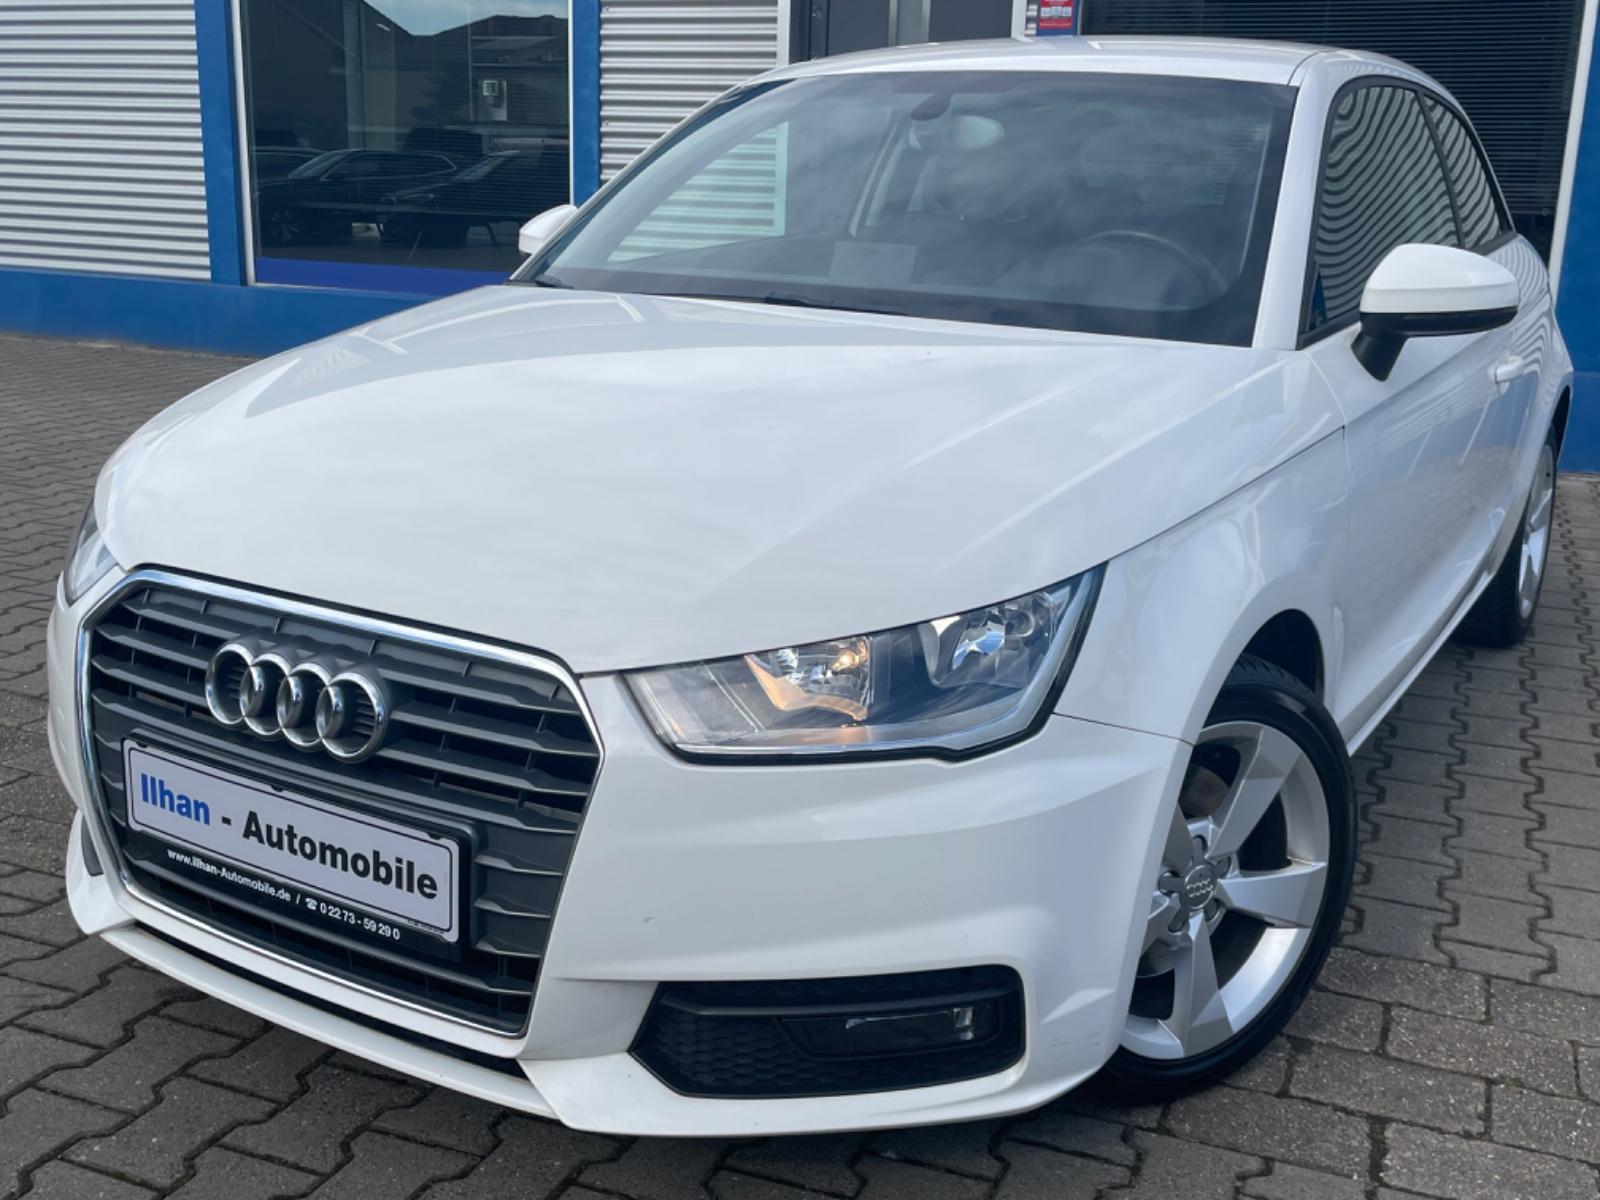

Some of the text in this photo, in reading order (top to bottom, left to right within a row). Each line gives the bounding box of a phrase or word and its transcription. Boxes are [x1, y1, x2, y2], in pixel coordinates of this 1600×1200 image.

[141, 773, 437, 899] Ilhan - Automobile
